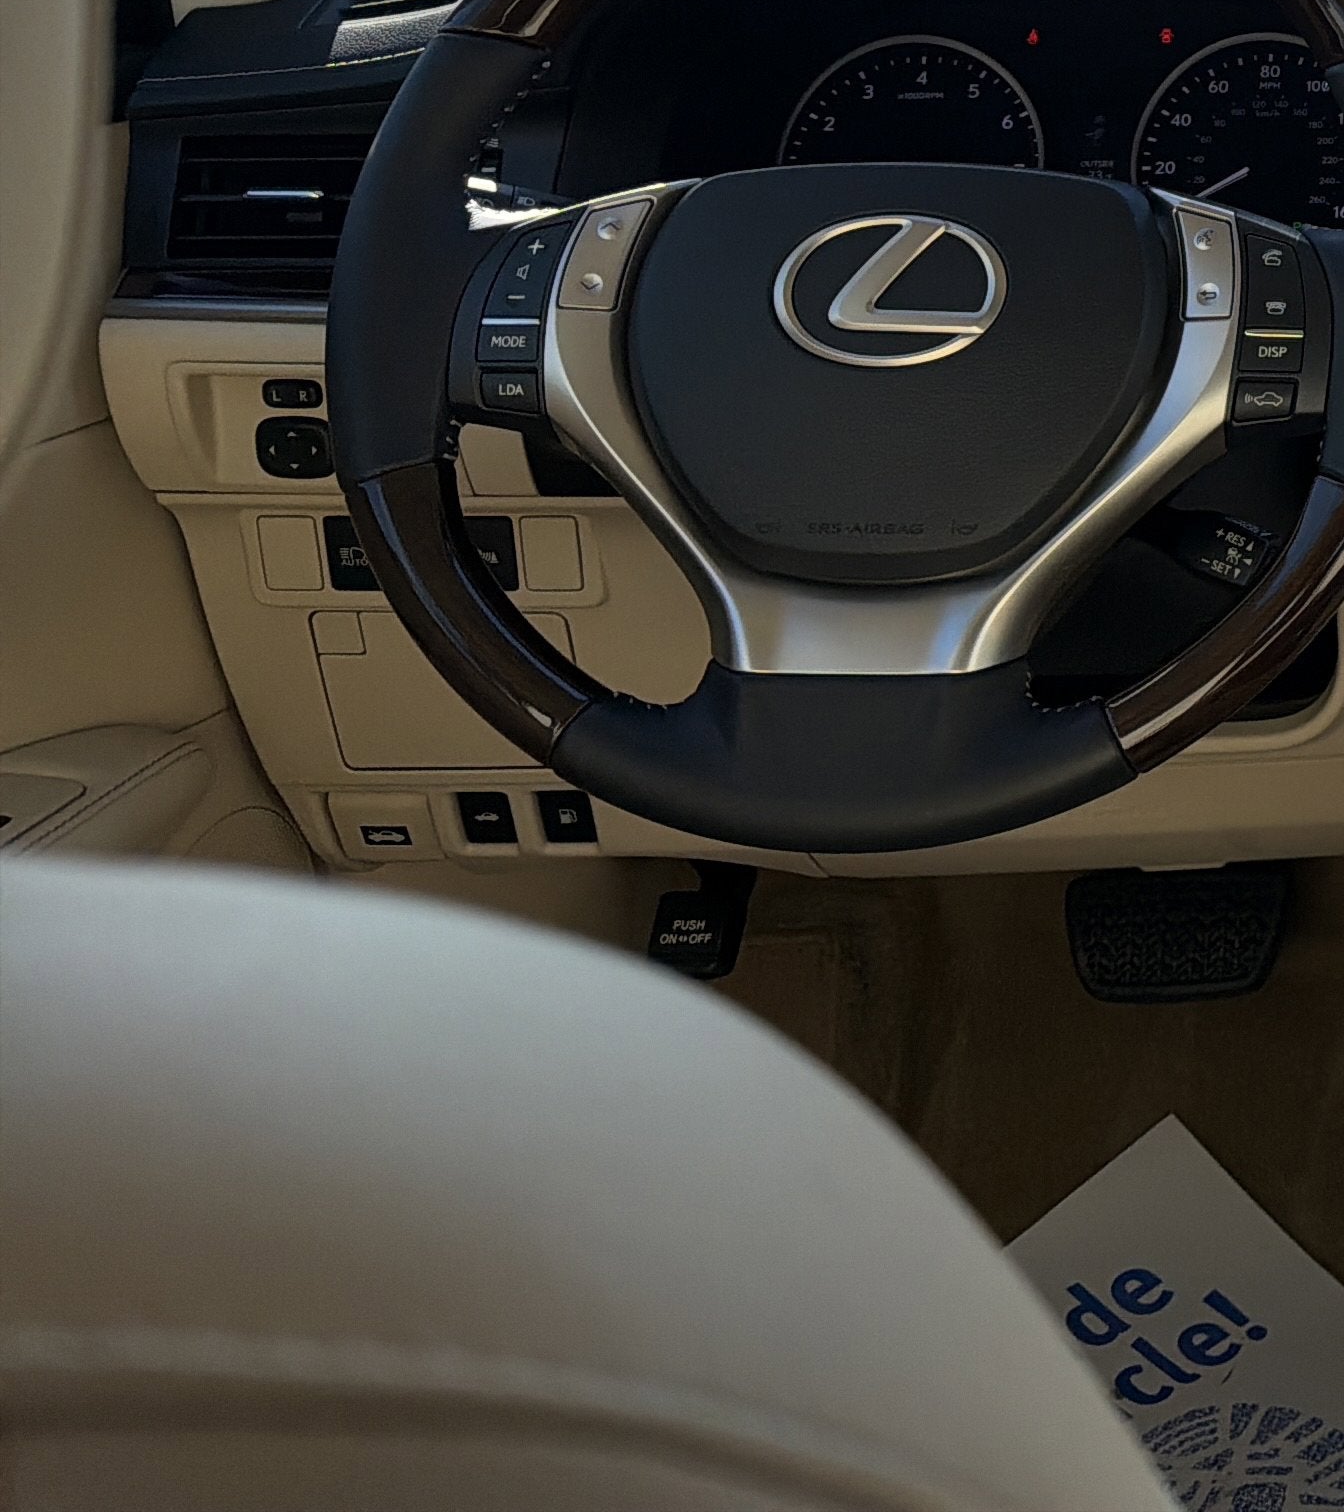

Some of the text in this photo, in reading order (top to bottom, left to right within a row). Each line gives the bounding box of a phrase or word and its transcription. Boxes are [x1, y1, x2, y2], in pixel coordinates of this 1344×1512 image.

[915, 71, 928, 85] 4
[1259, 65, 1281, 78] 80
[861, 85, 874, 99] 3
[967, 84, 981, 99] 5
[1208, 80, 1229, 94] 60
[1259, 82, 1281, 90] MPH
[823, 116, 836, 132] 2
[1001, 114, 1013, 129] 6
[1170, 114, 1192, 127] 40
[1155, 161, 1176, 175] 20
[490, 336, 526, 348] MODE
[1258, 345, 1288, 358] DISP
[272, 390, 281, 402] L
[299, 390, 308, 402] R
[498, 384, 524, 396] LDA
[672, 919, 706, 931] PUSH
[660, 933, 712, 944] ON OFF
